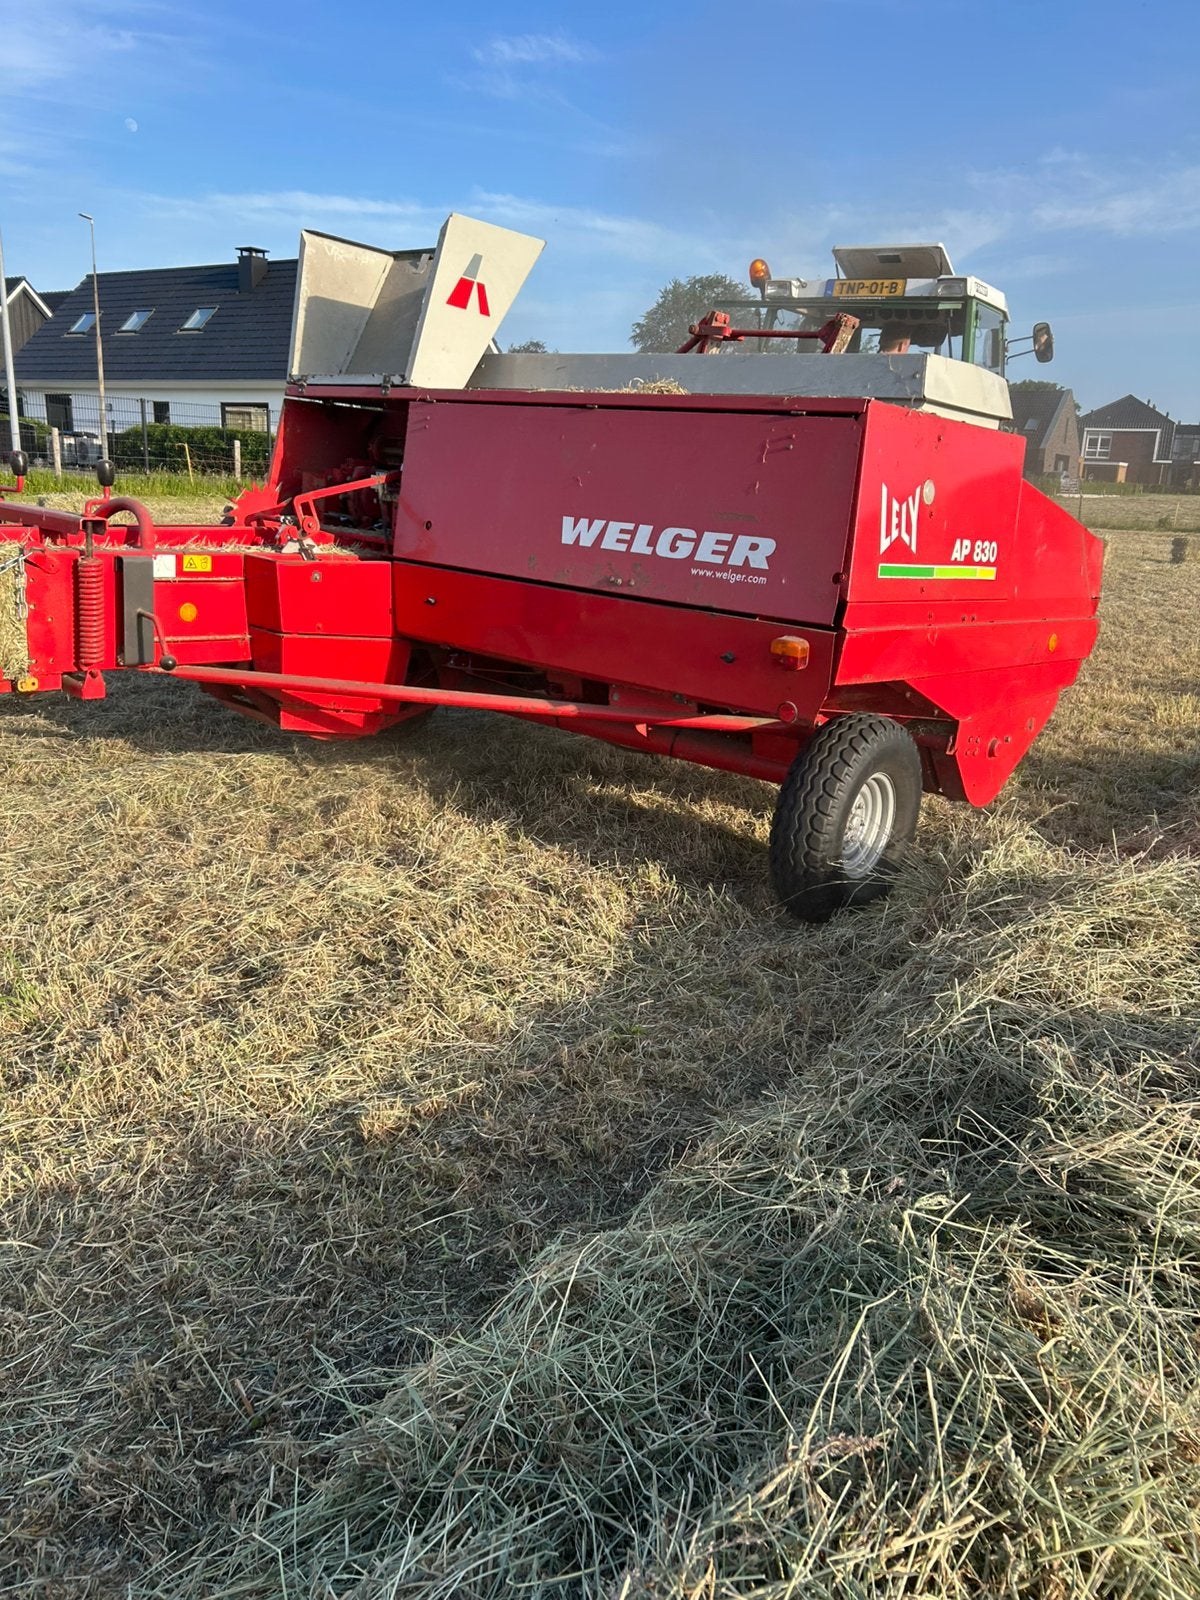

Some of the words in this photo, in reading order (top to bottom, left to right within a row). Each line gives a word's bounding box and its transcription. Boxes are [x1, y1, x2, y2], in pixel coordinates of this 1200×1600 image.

[839, 282, 899, 294] TNP-01-B
[880, 482, 921, 555] LELY
[561, 515, 777, 570] WELGER
[950, 538, 971, 562] AP
[973, 539, 998, 563] 830
[690, 567, 767, 585] www.welger.com
